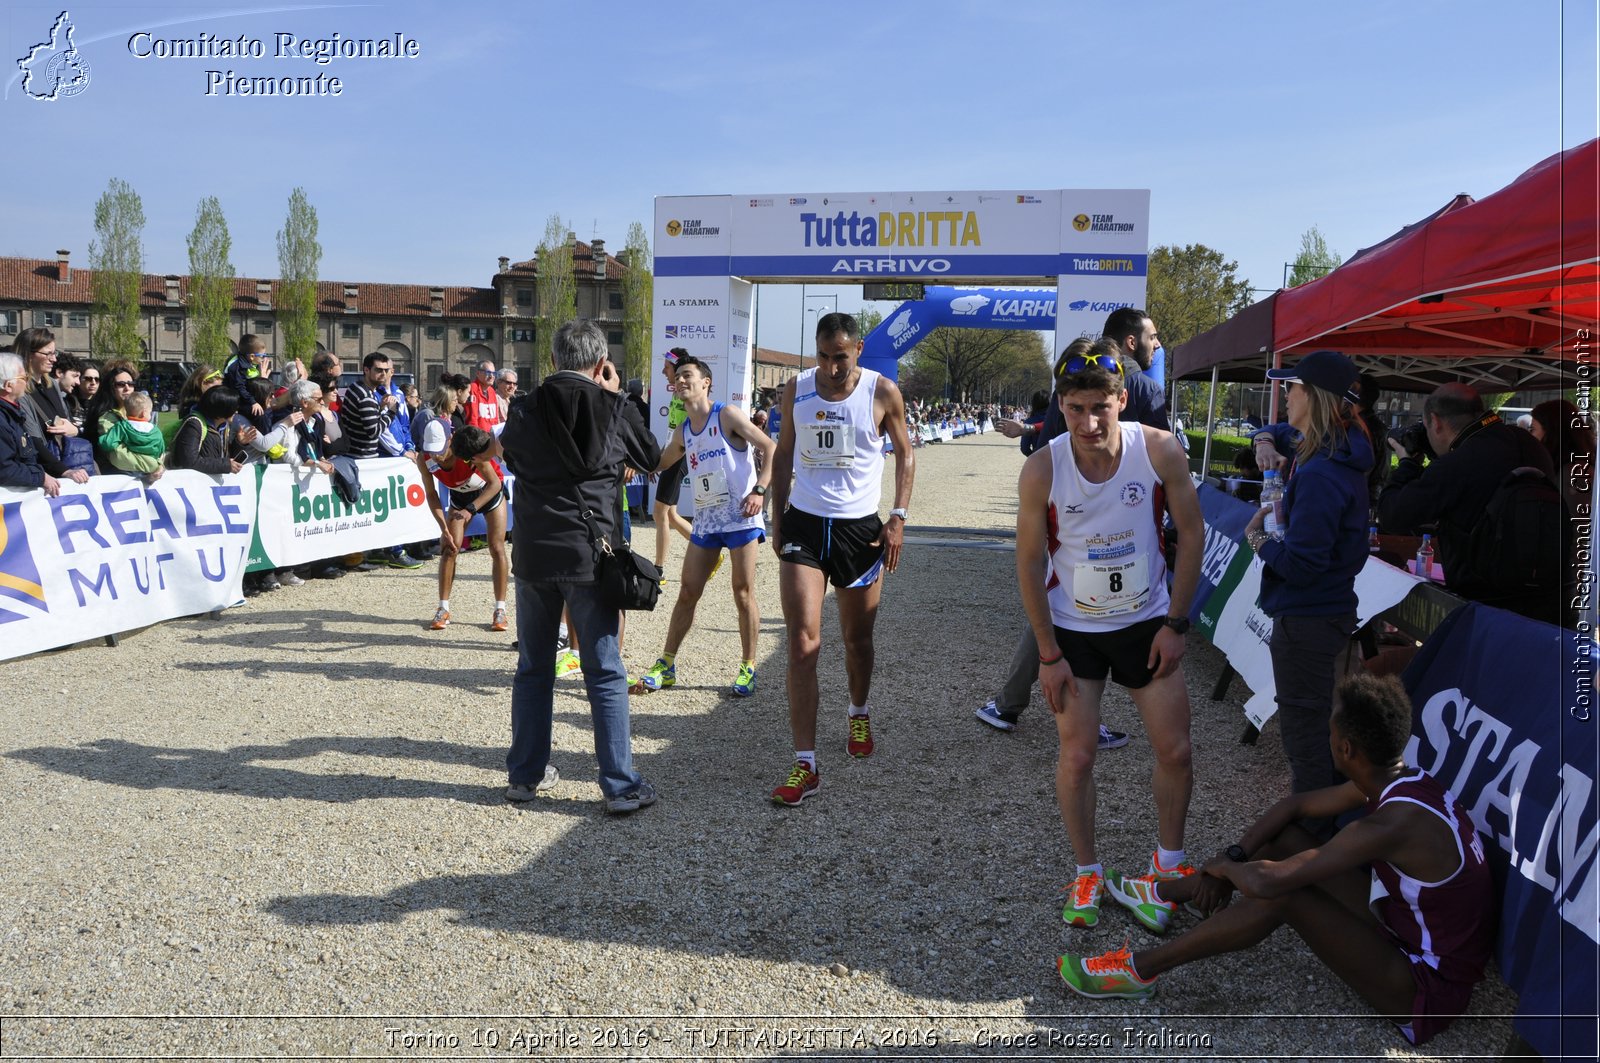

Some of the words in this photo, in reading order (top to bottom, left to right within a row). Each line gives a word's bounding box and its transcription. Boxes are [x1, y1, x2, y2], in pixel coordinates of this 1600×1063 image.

[1091, 214, 1114, 223] TEAM
[682, 227, 720, 236] MARATHON
[800, 211, 981, 247] TuttaDRITTA
[1090, 223, 1135, 232] MARATHON
[831, 259, 951, 272] ARRIVO
[1073, 258, 1133, 271] TuttaDRITTA
[663, 299, 676, 307] LA
[679, 299, 719, 307] STAMPA
[991, 299, 1056, 317] KARHU
[680, 325, 716, 333] REALE
[893, 322, 920, 350] KARHU
[816, 430, 834, 449] 10
[702, 478, 710, 492] 9
[45, 485, 250, 554] REALE
[294, 528, 302, 538] la
[303, 525, 323, 539] frutta
[325, 523, 333, 533] ha
[335, 521, 350, 534] fatto
[351, 517, 372, 529] strada
[1086, 531, 1135, 545] MOLINARI
[1088, 545, 1125, 553] MECCANICA
[67, 546, 245, 607] MUTU
[1109, 572, 1123, 593] 8
